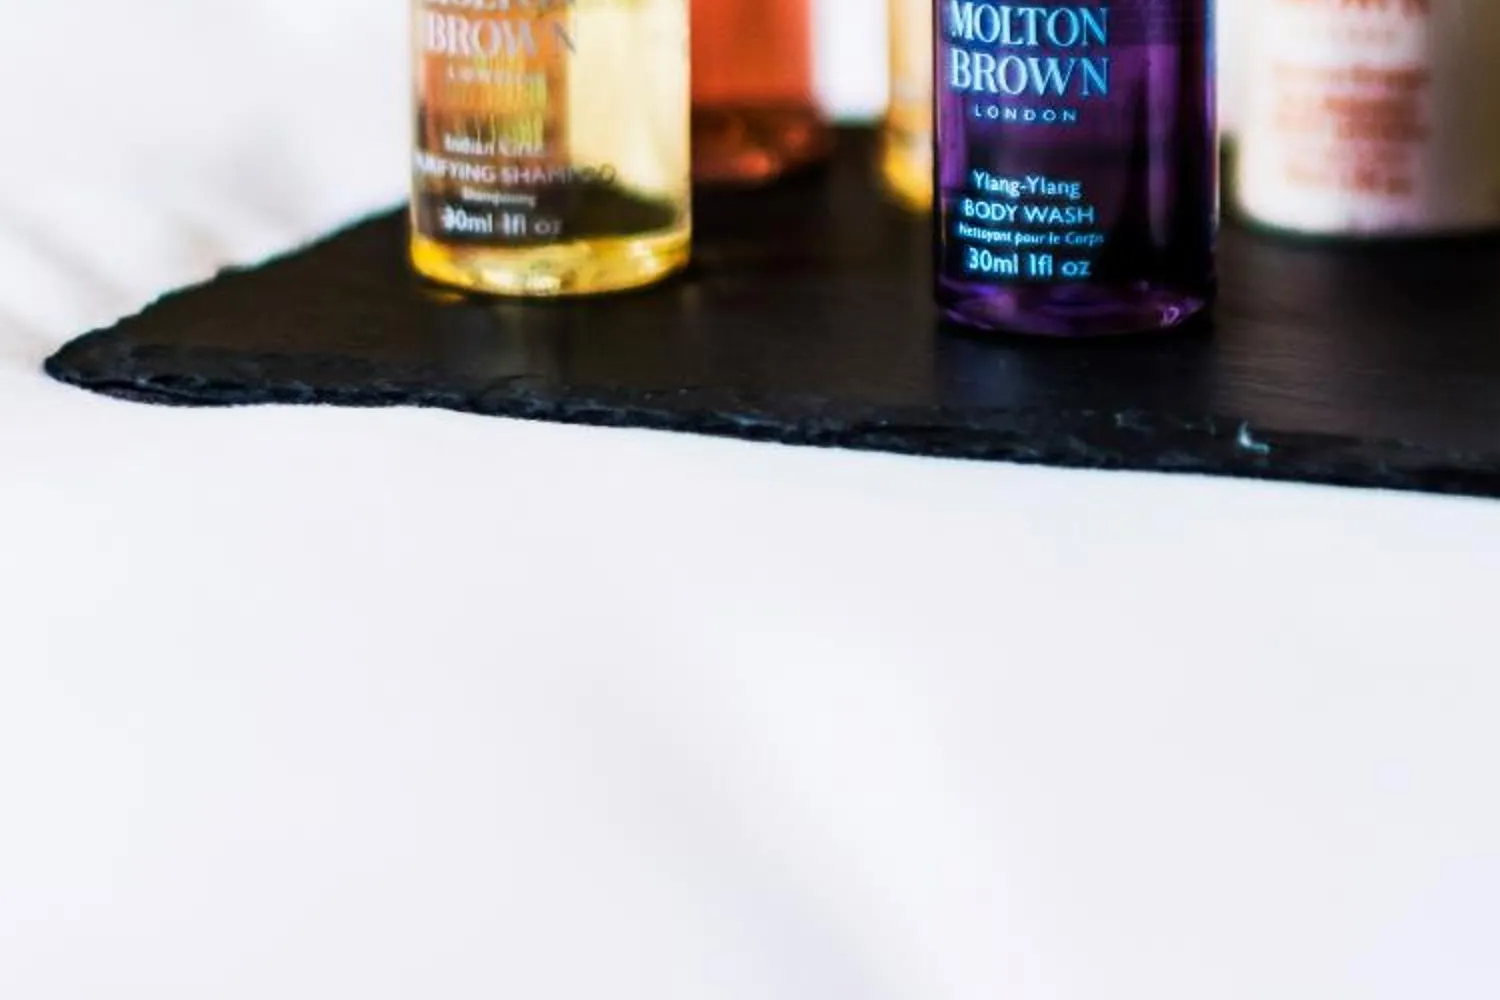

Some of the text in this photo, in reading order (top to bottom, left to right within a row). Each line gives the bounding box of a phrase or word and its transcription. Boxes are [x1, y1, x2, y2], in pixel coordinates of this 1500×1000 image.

[949, 47, 1109, 97] BROWN
[974, 104, 1077, 121] LONDON
[973, 169, 1082, 199] Ylang-Ylang
[964, 198, 1095, 224] BODY WASH
[968, 247, 1018, 275] 30ml
[1061, 260, 1092, 277] oz
